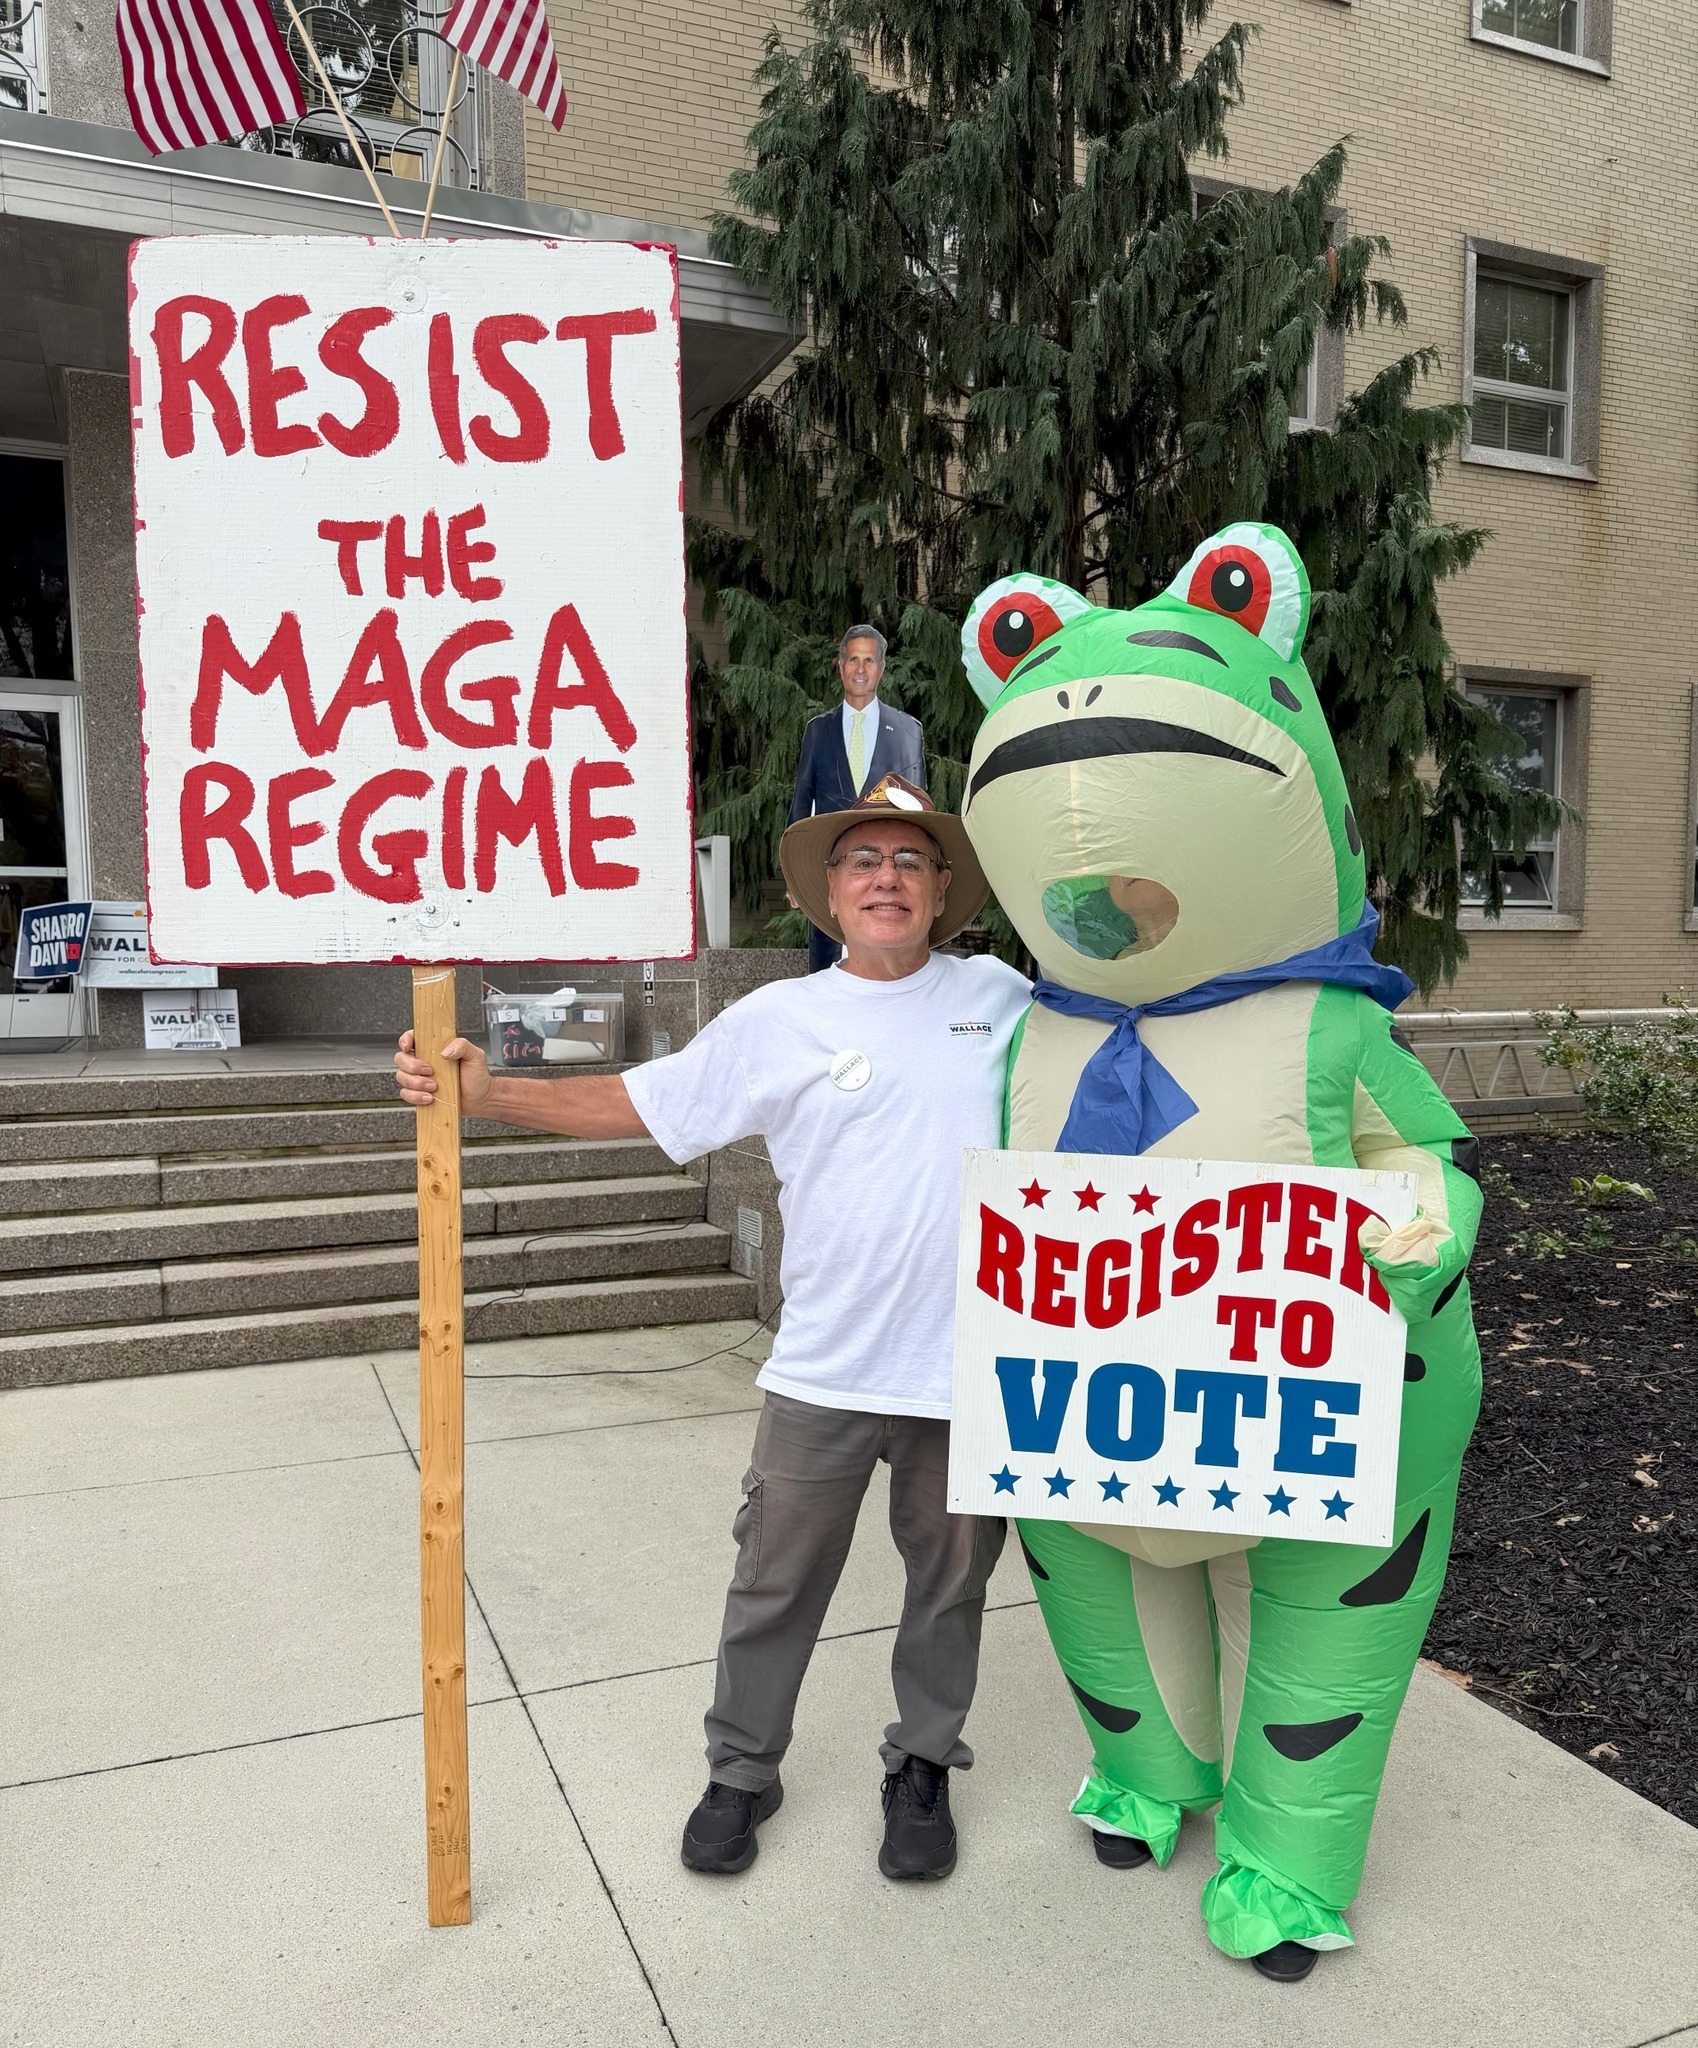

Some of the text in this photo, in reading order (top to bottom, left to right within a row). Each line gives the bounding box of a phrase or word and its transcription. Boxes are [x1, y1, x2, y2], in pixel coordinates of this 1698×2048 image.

[150, 294, 656, 465] RESIST
[318, 503, 505, 602] THE
[190, 603, 638, 756] MAGA
[180, 757, 640, 904] REGIME
[553, 1011, 560, 1020] L
[833, 1054, 864, 1082] WALLACE
[949, 1025, 992, 1033] WALLACE
[976, 1182, 1392, 1329] REGISTER
[1216, 1294, 1334, 1369] TO
[995, 1356, 1361, 1479] VOTE
